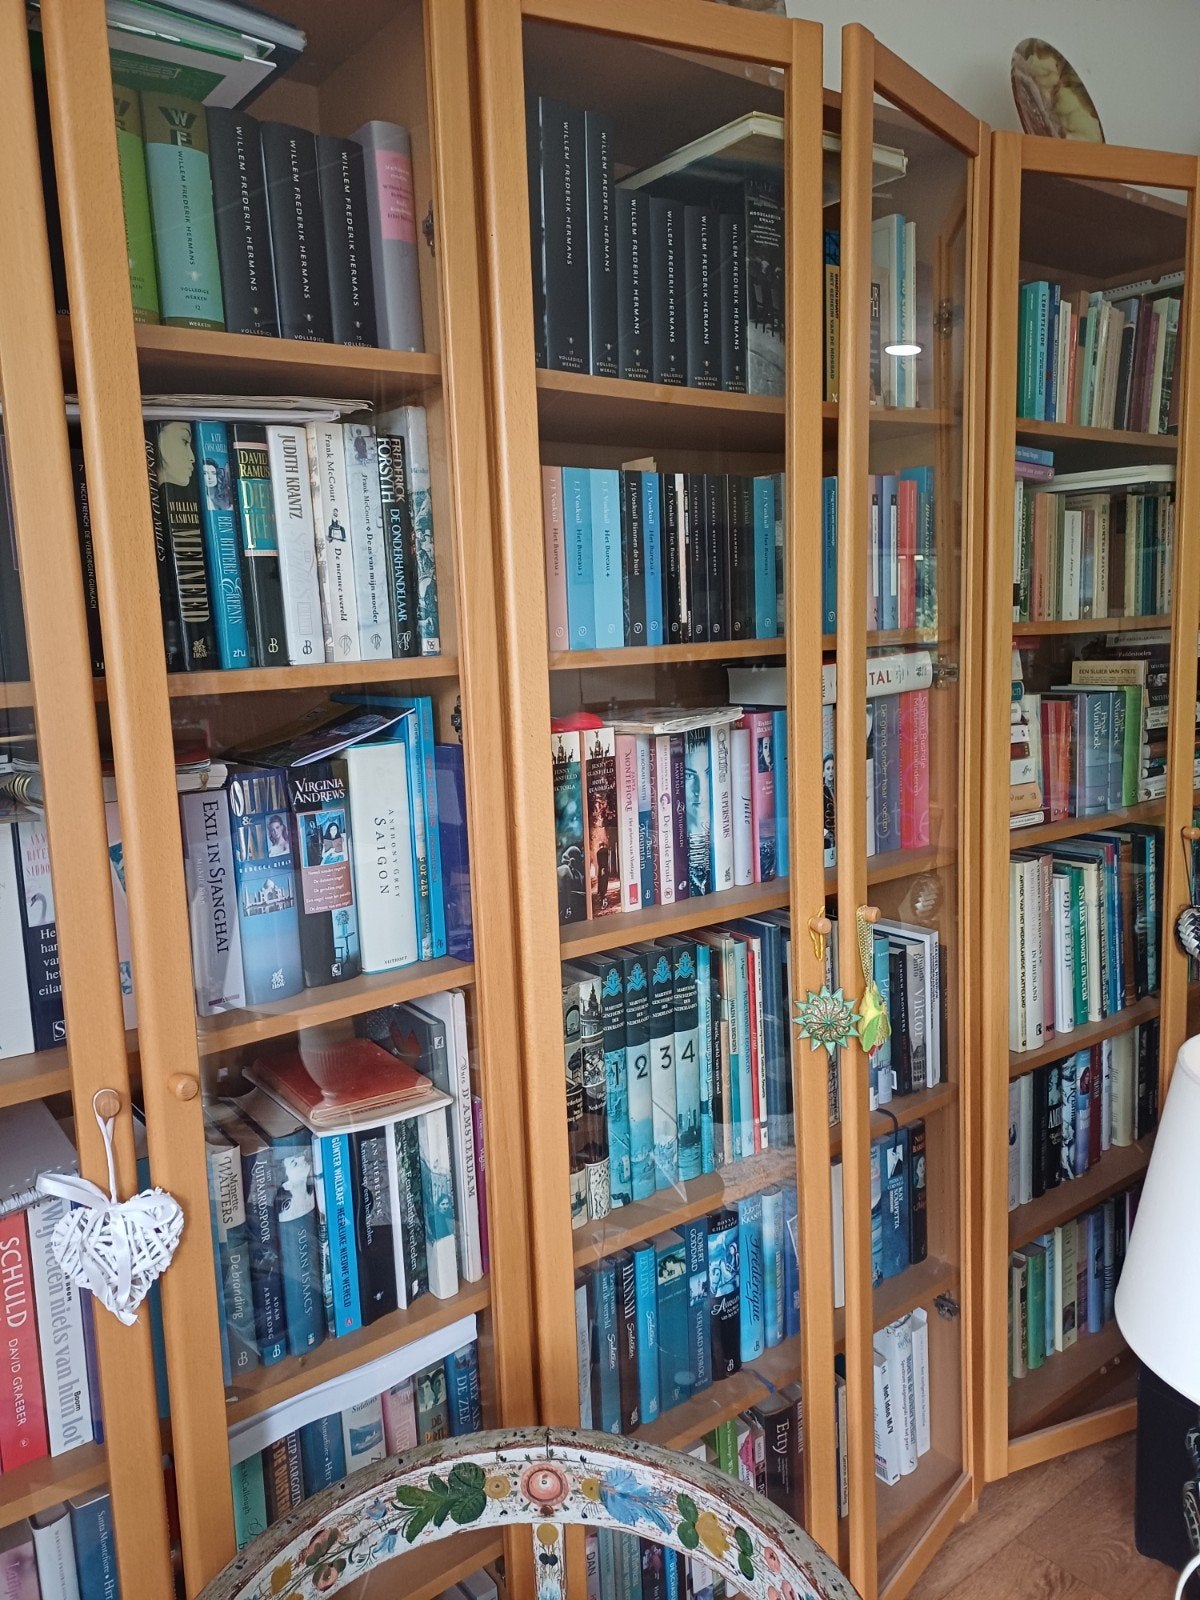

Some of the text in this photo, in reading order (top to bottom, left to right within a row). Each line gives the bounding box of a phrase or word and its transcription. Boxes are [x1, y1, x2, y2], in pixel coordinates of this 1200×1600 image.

[178, 151, 195, 266] WILLEM FREDERIK HERMANS
[236, 126, 257, 292] WILLEM FREDERIK HERMANS
[289, 140, 311, 299] WILLEM FREDERIK HERMANS
[341, 152, 360, 306] WILLEM FREDERIK HERMANS
[565, 217, 573, 266] HERMANS
[603, 225, 611, 273] HERMANS
[240, 450, 268, 464] DAVID
[325, 433, 333, 459] Frank
[377, 437, 393, 503] FORSYTH
[390, 438, 406, 502] FREDERICK
[240, 463, 270, 478] RAMUS
[277, 433, 303, 519] JUDITH KRANTZ
[326, 462, 336, 502] McCourt
[82, 502, 90, 527] FRENCH
[169, 501, 198, 512] WILLIAM
[84, 530, 91, 539] DE
[334, 548, 342, 562] De
[85, 541, 95, 578] VERBORGEN
[172, 528, 209, 623] MEINEED
[217, 516, 243, 624] EEN BITTERE ERFENIS
[389, 509, 408, 622] DE ONDERHANDELAAR
[338, 595, 348, 621] wereld
[919, 697, 927, 728] Salman
[295, 778, 344, 793] VIRGINIA
[624, 751, 633, 812] MONTEFIORE
[879, 704, 889, 832] De grond onder haar voeten
[293, 789, 346, 805] ANDREWS
[721, 791, 731, 839] SUPERSTARS
[374, 817, 390, 895] SAIGON
[388, 809, 401, 898] ANTHONY GREY
[662, 815, 673, 882] De joodse bruid
[202, 800, 230, 954] EXIL IN SJANGHAI
[913, 988, 926, 1038] Viktor
[635, 1055, 648, 1080] 2
[660, 1044, 672, 1069] 3
[681, 1040, 695, 1063] 4
[217, 1157, 233, 1225] WALTERS
[228, 1174, 239, 1211] Minette
[370, 1137, 383, 1217] JAN SIEBELINK
[251, 1160, 271, 1244] LUIPAARDSPOOR
[331, 1136, 351, 1308] GÜNTER WALLRAFF HEERLIJKE NIEUWE WERELD
[406, 1191, 414, 1227] dichtbij
[893, 1188, 901, 1229] SCARPETTA
[297, 1228, 313, 1315] SUSAN ISAACS
[690, 1228, 698, 1272] GODDARD
[0, 1236, 27, 1328] SCHULD
[230, 1254, 246, 1321] De branding
[622, 1262, 635, 1319] HANNAH
[51, 1300, 68, 1343] niets
[264, 1287, 275, 1341] ARMSTRONG
[8, 1338, 27, 1427] DAVID GRAEBER
[54, 1346, 71, 1380] van
[58, 1380, 80, 1417] hun
[73, 1391, 81, 1412] Boom
[457, 1376, 470, 1425] DE ZEE
[471, 1405, 481, 1431] ALS
[62, 1417, 84, 1447] lot
[773, 1418, 790, 1454] Etty
[287, 1455, 301, 1507] MARGOLIN
[97, 1510, 106, 1534] Santa
[99, 1533, 110, 1574] Montefiore
[586, 1552, 596, 1576] DAN
